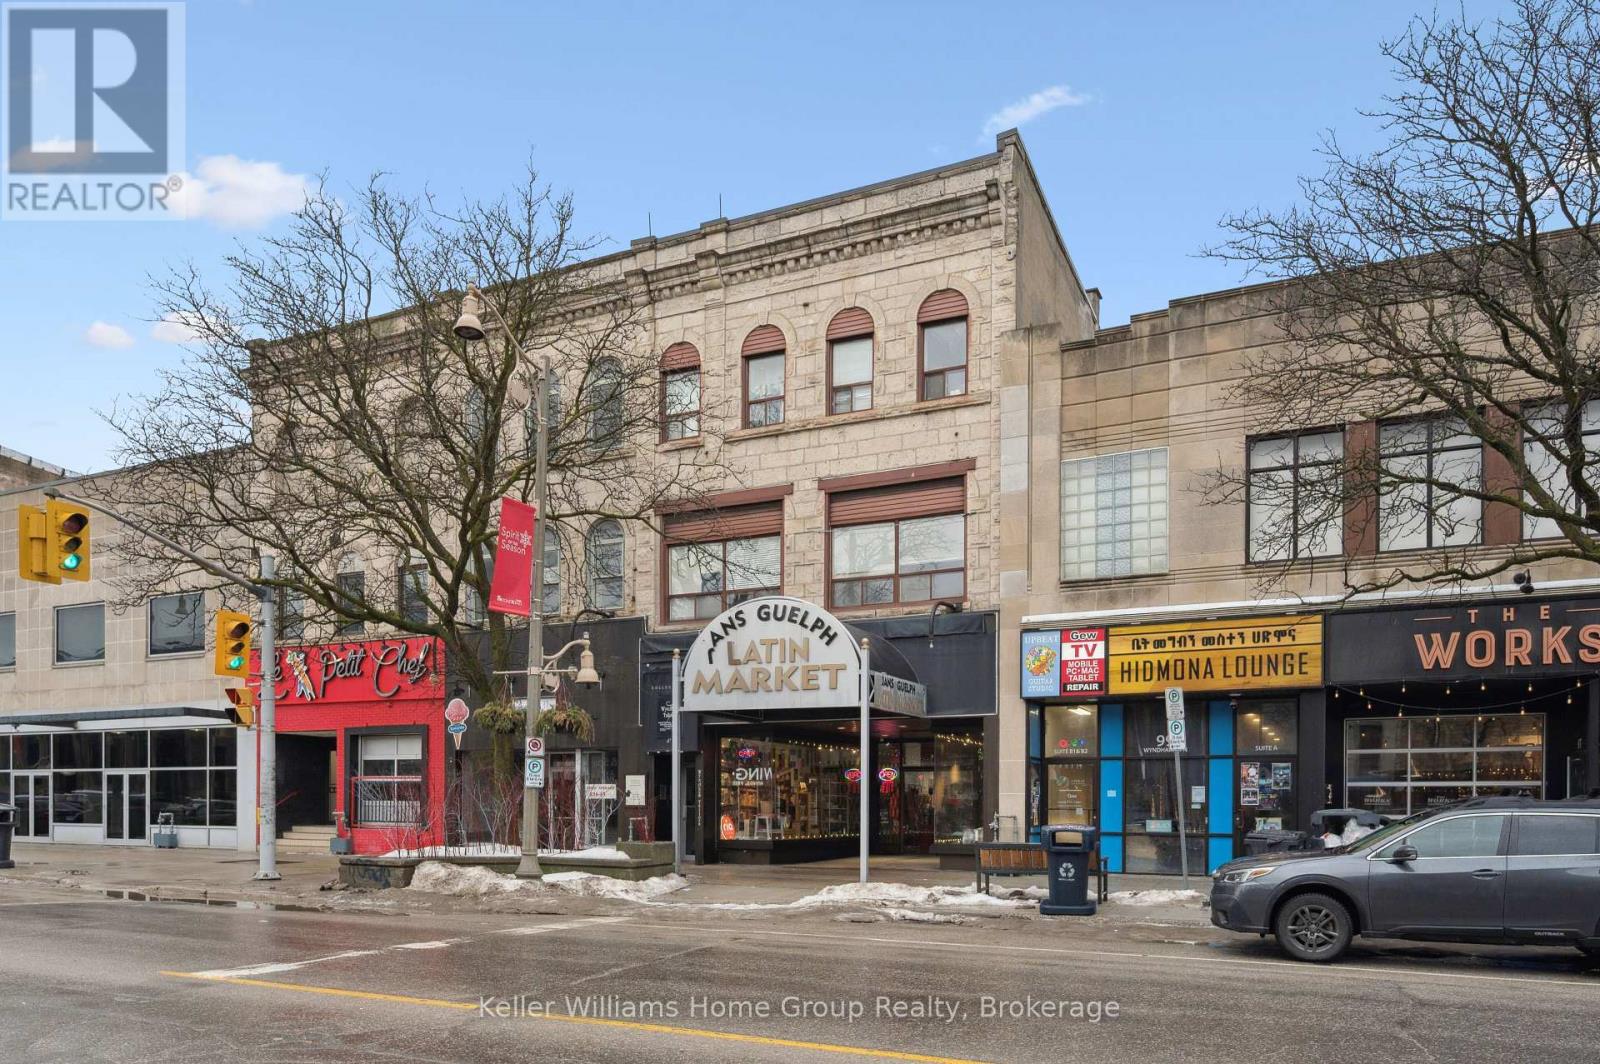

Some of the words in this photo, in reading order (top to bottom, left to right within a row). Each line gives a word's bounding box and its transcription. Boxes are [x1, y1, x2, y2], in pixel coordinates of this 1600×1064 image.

[501, 540, 526, 556] Season
[1467, 605, 1550, 624] THE
[757, 604, 838, 646] GUELPH
[1070, 631, 1097, 641] Gew
[726, 637, 810, 666] LATIN
[1071, 643, 1097, 658] TV
[1413, 623, 1600, 670] WORKS
[320, 650, 366, 698] Petit
[370, 643, 430, 698] Chef
[1067, 660, 1098, 668] MOBILE
[1120, 657, 1215, 683] HIDMONA
[1222, 652, 1309, 679] LOUNGE
[692, 663, 847, 695] MARKET
[1066, 683, 1099, 692] REPAIR
[1068, 674, 1099, 682] TABLET
